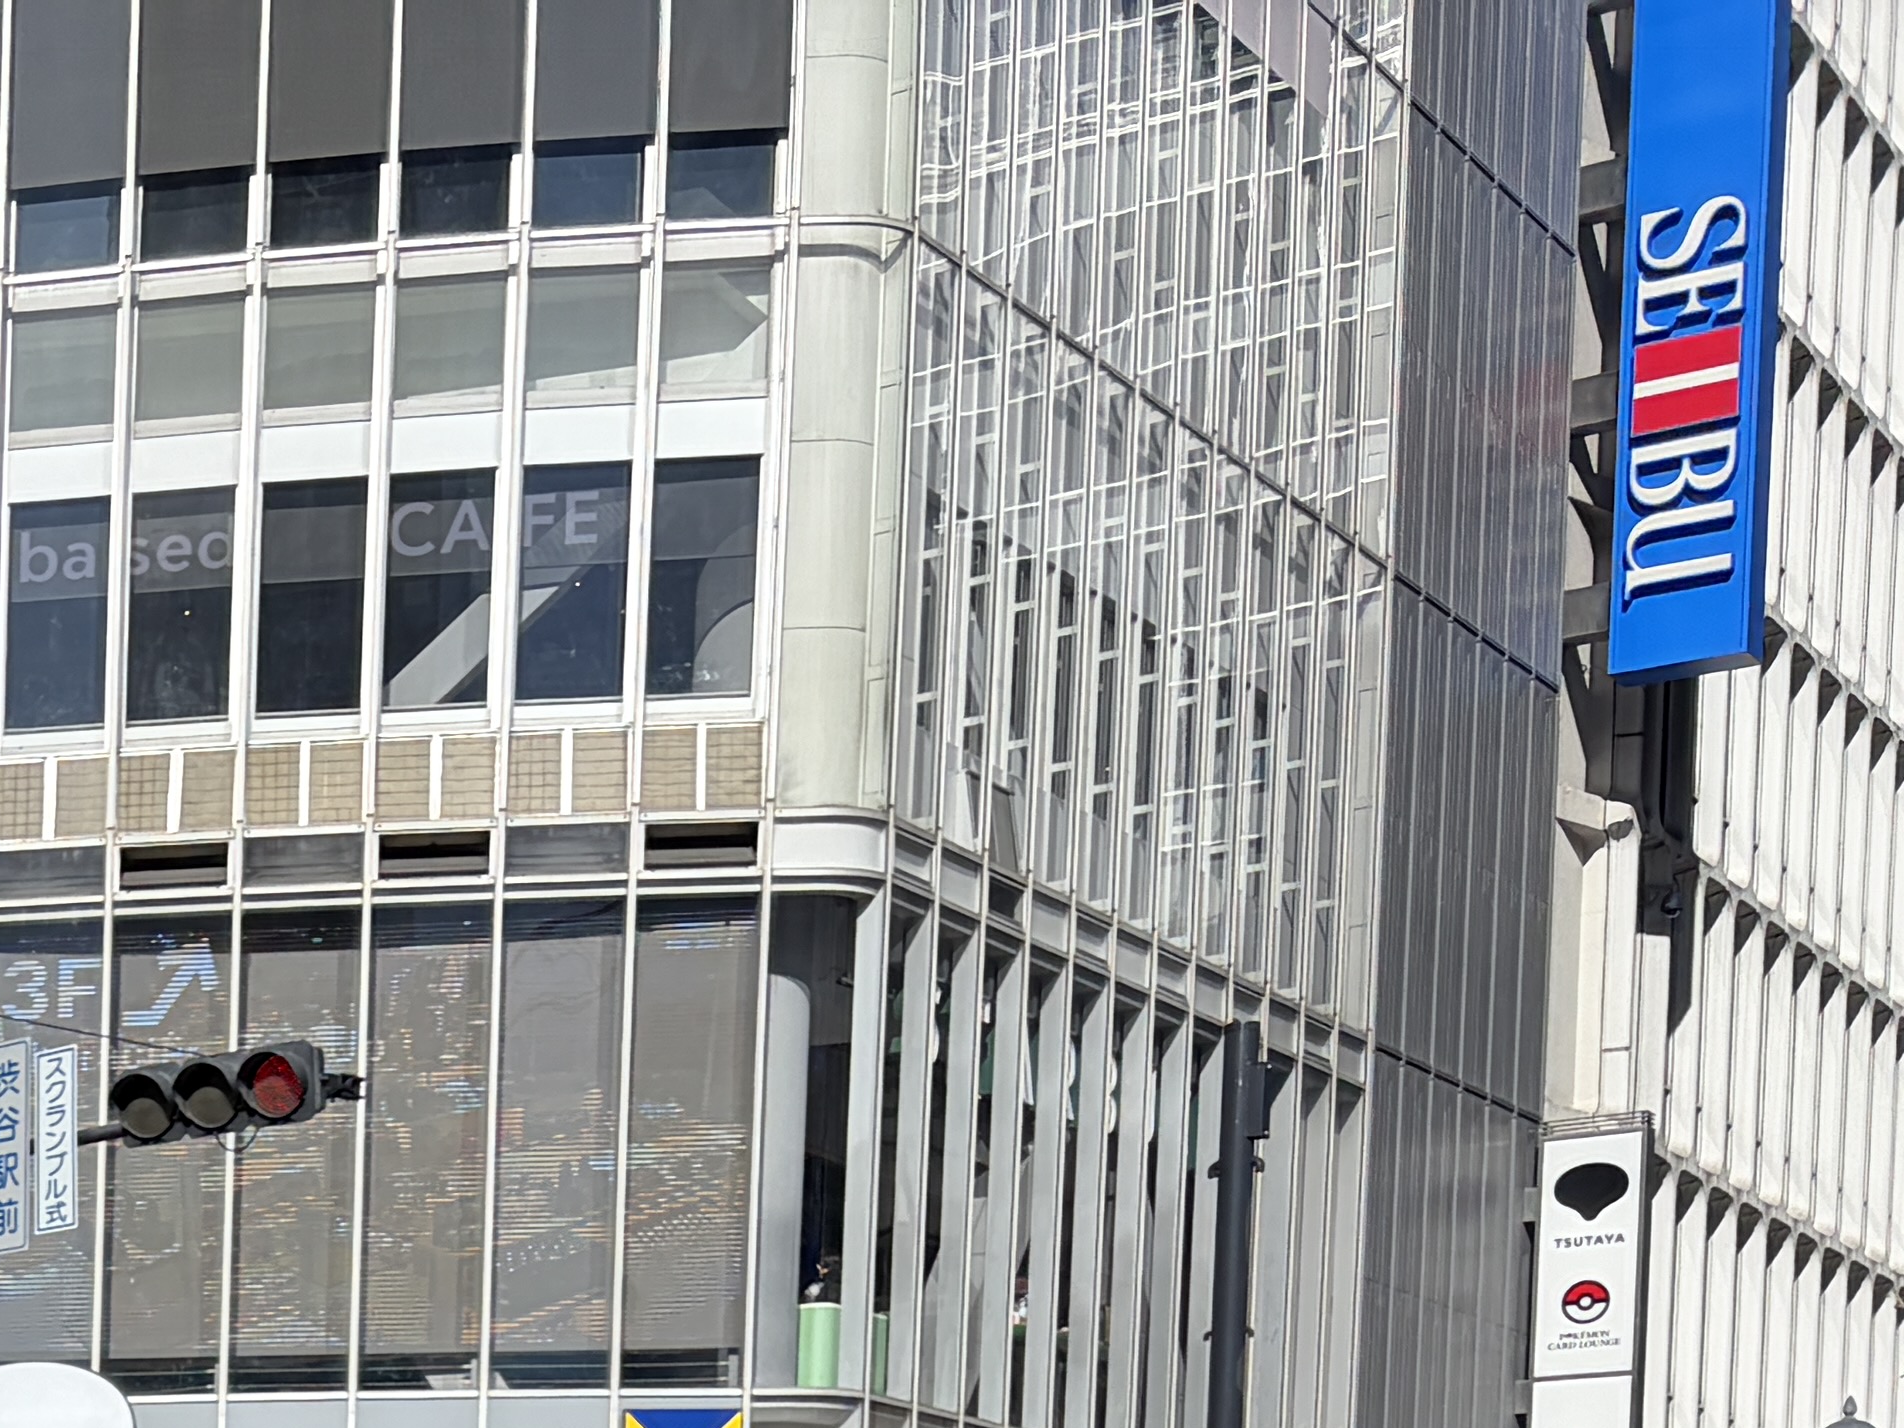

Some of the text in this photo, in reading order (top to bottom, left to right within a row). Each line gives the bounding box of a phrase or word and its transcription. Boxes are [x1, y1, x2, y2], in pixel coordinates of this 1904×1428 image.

[1624, 194, 1747, 604] SEIBU
[19, 525, 233, 584] based
[391, 490, 601, 557] CAFE
[43, 1055, 69, 1226] スクランブル式
[1554, 1233, 1625, 1248] TSUTAYA
[1578, 1338, 1621, 1349] LOUNGE
